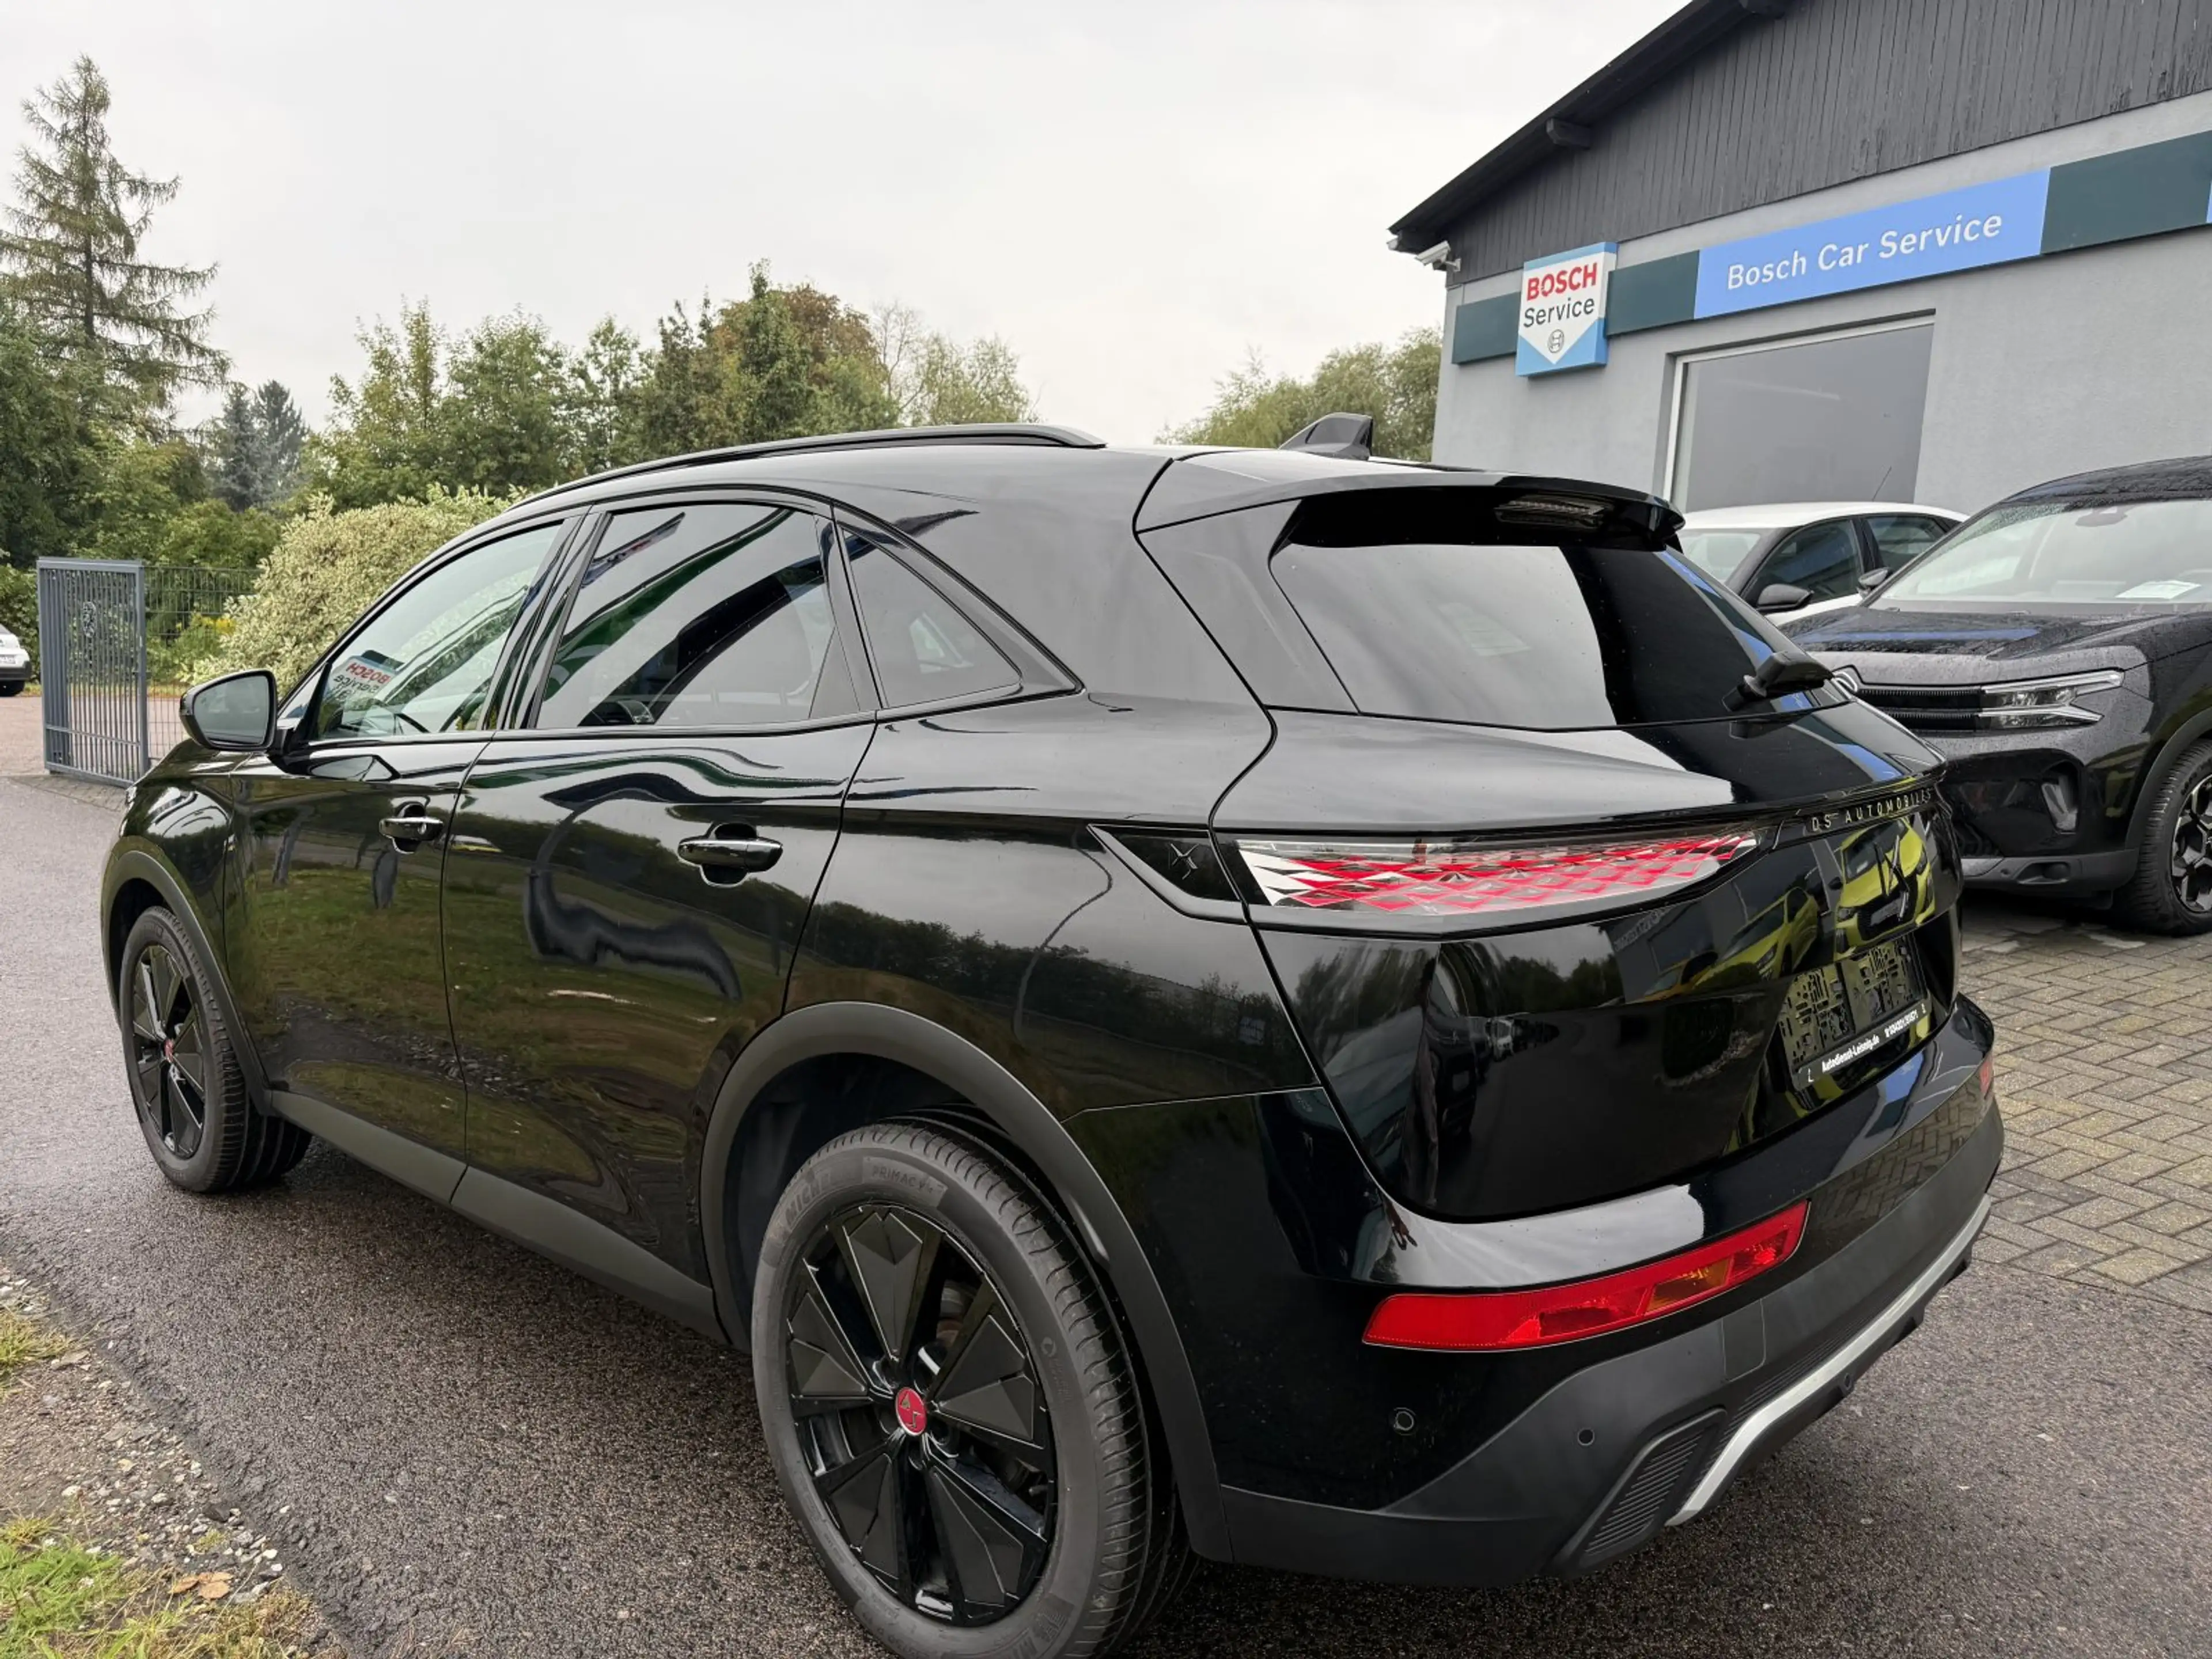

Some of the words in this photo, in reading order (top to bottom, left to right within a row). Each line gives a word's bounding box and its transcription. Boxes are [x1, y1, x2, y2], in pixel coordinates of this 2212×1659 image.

[1728, 250, 1806, 289] Bosch
[1818, 241, 1869, 271] Car
[1879, 214, 2002, 259] Service
[1527, 262, 1597, 301] BOSCH
[1522, 297, 1596, 328] Service
[1812, 814, 1832, 831] DS
[1845, 787, 1931, 824] AUTOMOBILES
